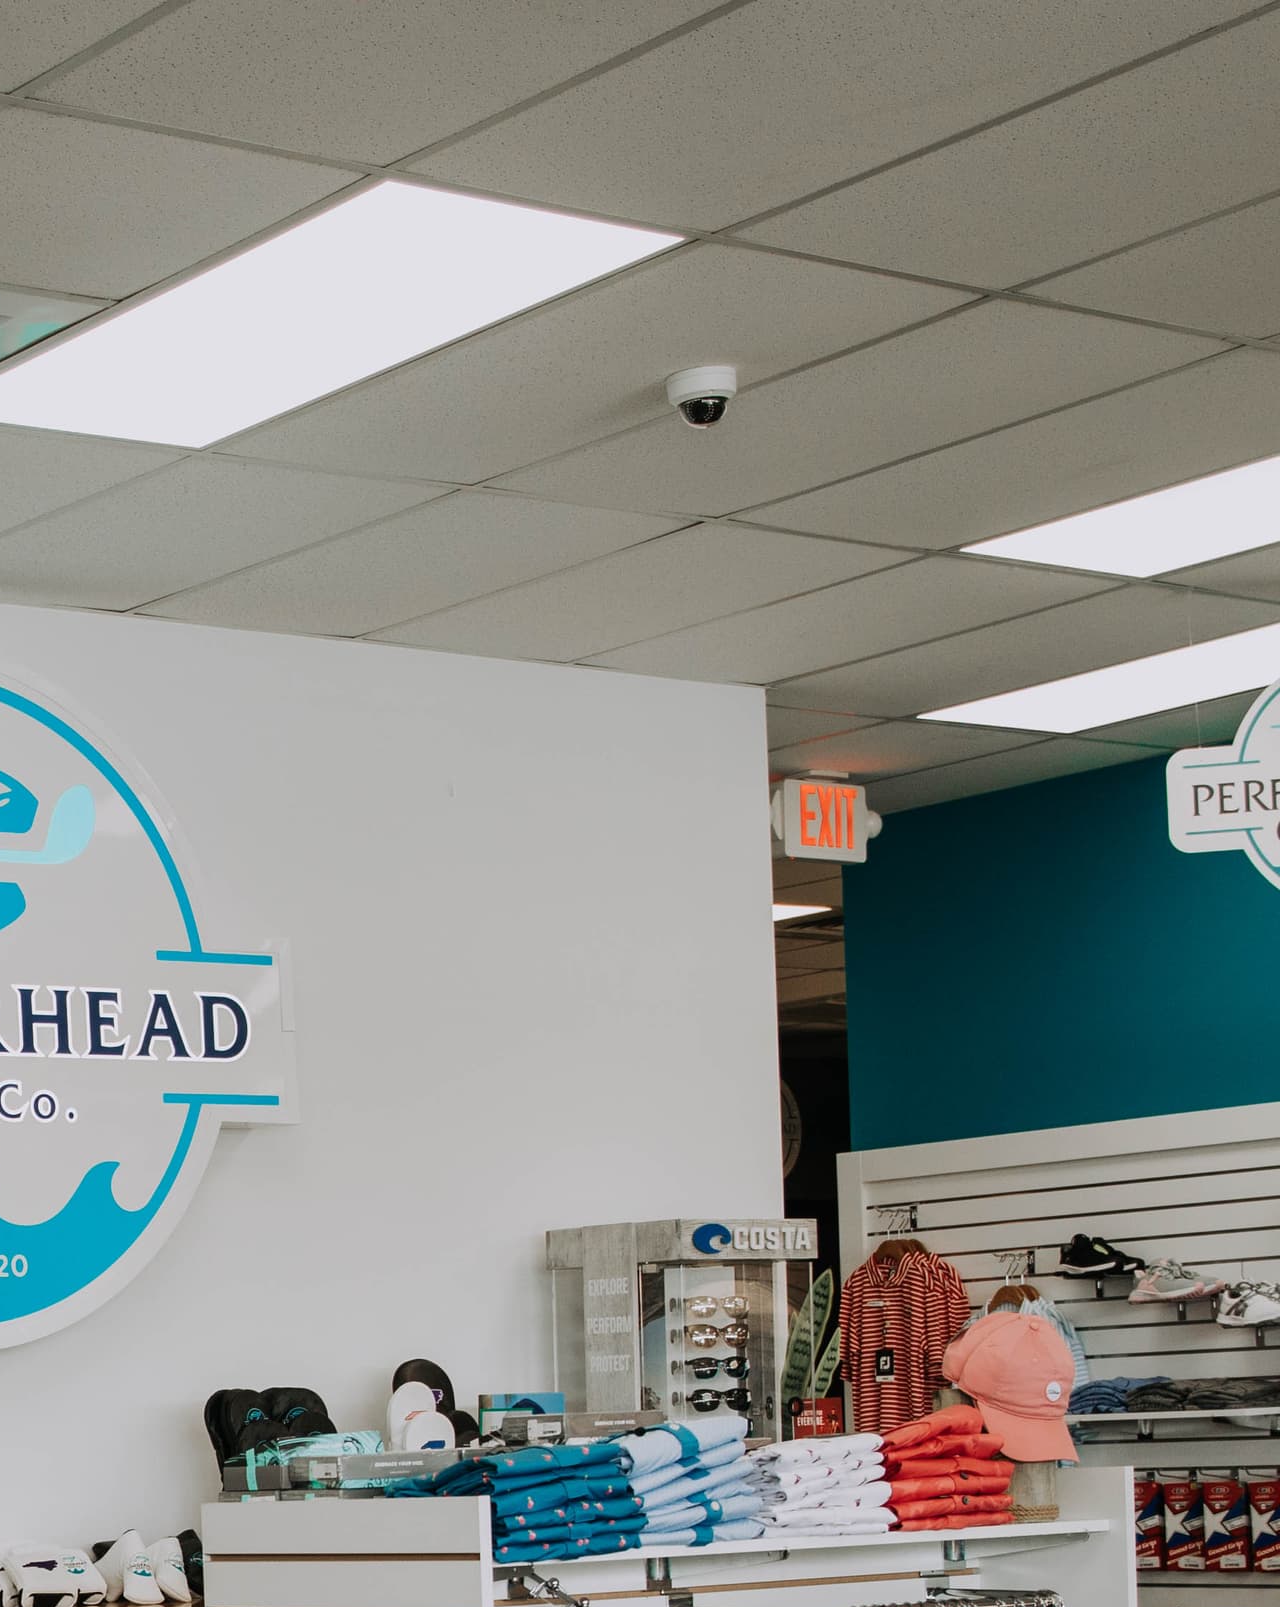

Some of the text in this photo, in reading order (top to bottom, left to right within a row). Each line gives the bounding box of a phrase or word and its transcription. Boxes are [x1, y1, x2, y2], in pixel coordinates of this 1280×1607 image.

[800, 784, 858, 850] EXIT
[733, 1226, 811, 1250] COSTA
[588, 1277, 629, 1296] EXPLORE
[587, 1316, 632, 1334] PERFORM
[590, 1354, 631, 1372] PROTECT
